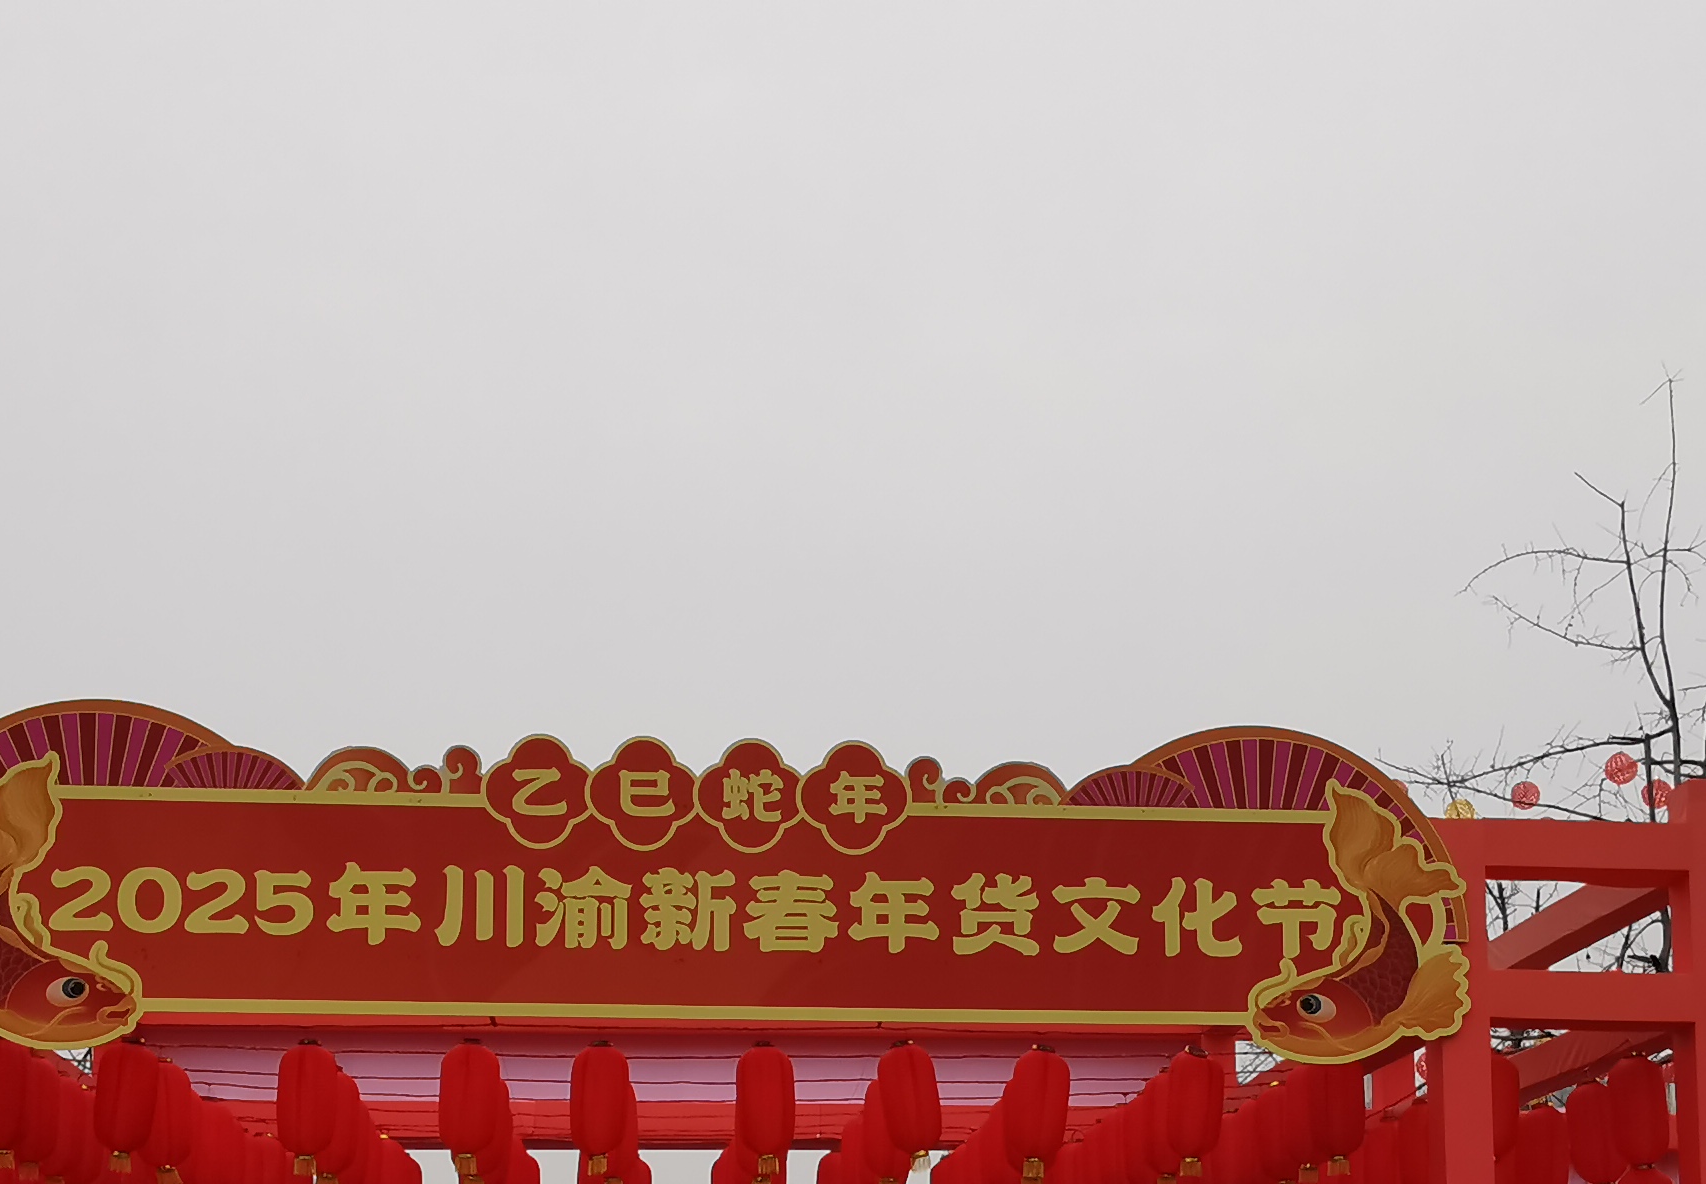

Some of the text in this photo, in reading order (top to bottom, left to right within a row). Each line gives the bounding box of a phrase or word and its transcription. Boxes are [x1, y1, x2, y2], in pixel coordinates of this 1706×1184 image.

[512, 767, 888, 824] 乙巳蛇年
[48, 861, 1342, 958] 2025年川渝新春年货文化节
